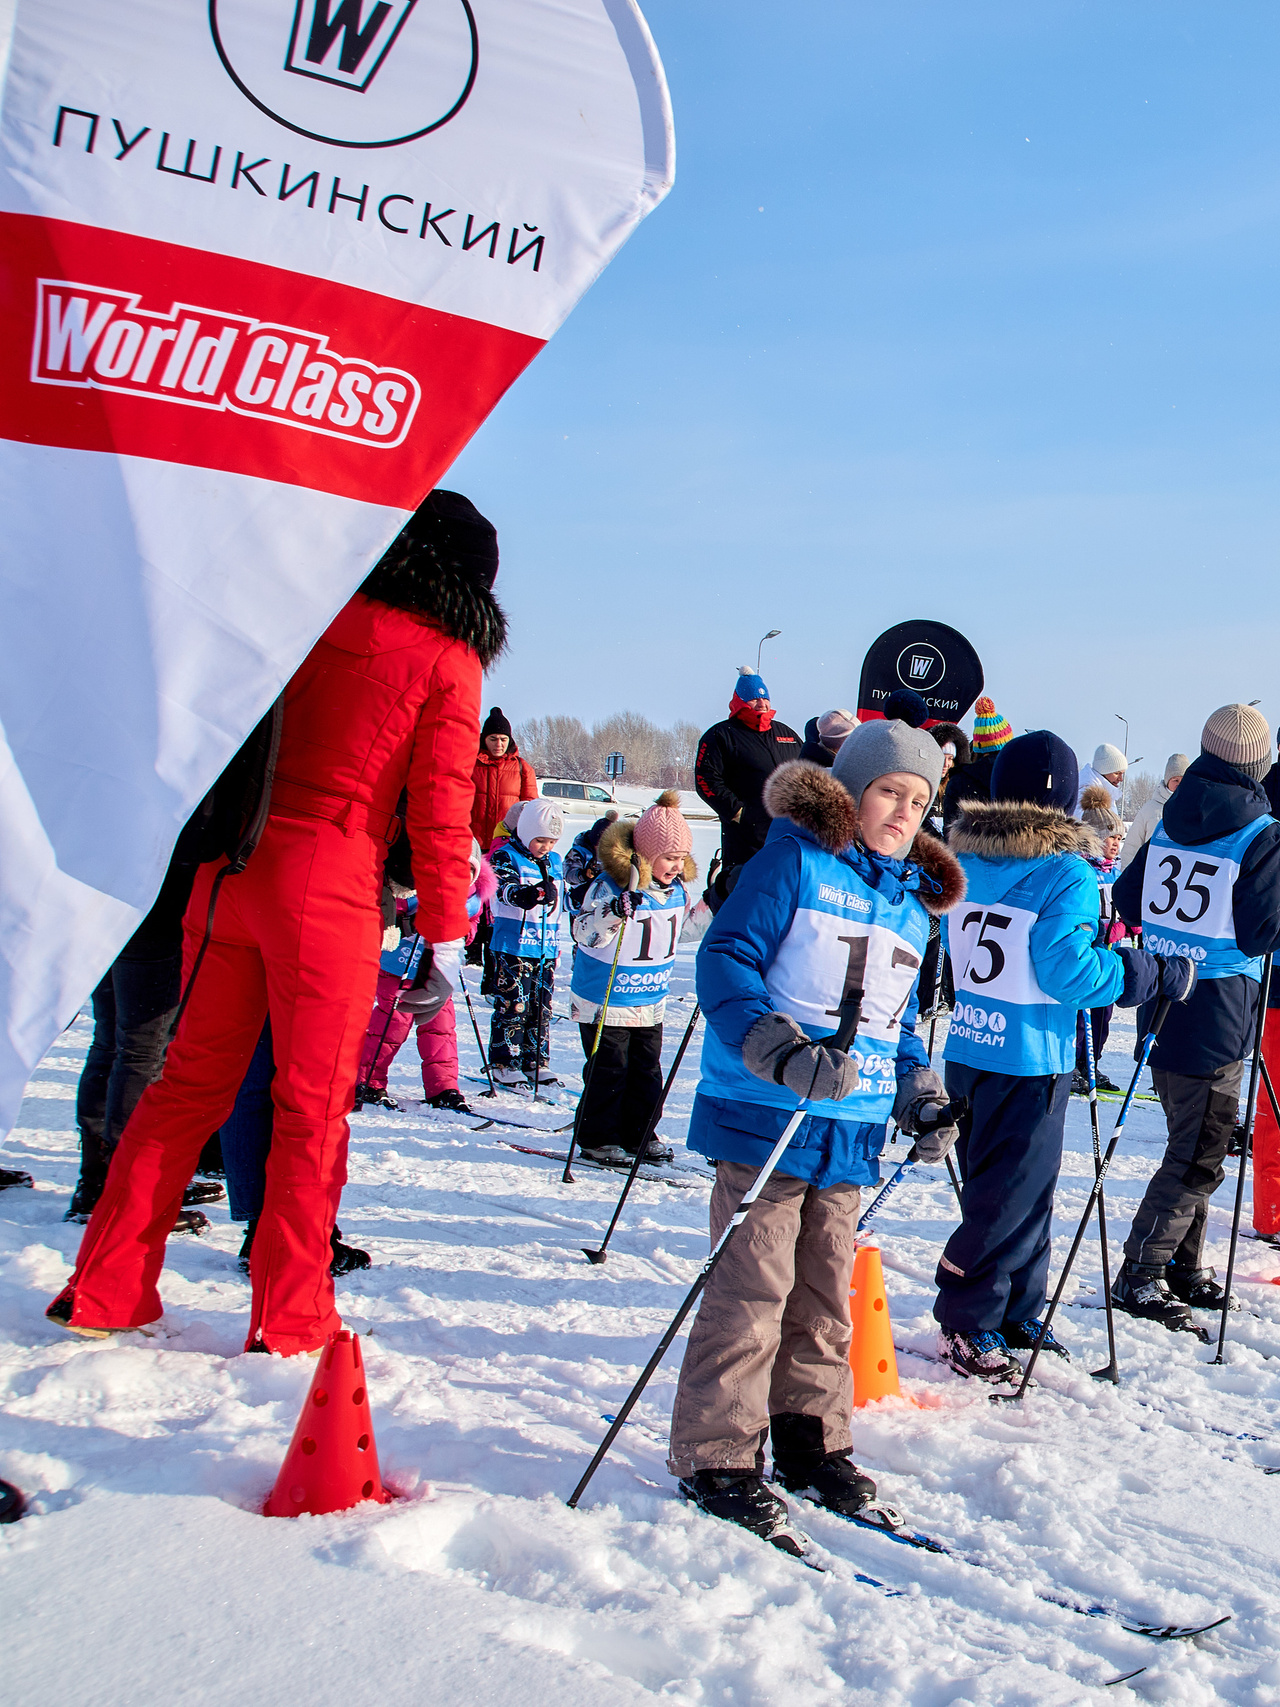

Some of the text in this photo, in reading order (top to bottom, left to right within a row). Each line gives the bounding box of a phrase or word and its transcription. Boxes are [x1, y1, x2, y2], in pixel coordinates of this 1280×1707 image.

[53, 105, 546, 272] ПУШКИНСКИЙ
[46, 293, 407, 437] World Class
[913, 659, 930, 675] W
[872, 689, 959, 710] ПУСКИЙ
[820, 885, 872, 912] World Class
[1149, 855, 1220, 923] 35
[632, 914, 677, 961] 11
[961, 911, 1013, 985] 75
[613, 984, 661, 993] OUTDOOR
[825, 935, 920, 1030] 17
[1094, 1157, 1110, 1196] NORDWAY
[861, 1177, 899, 1226] NORDWAY
